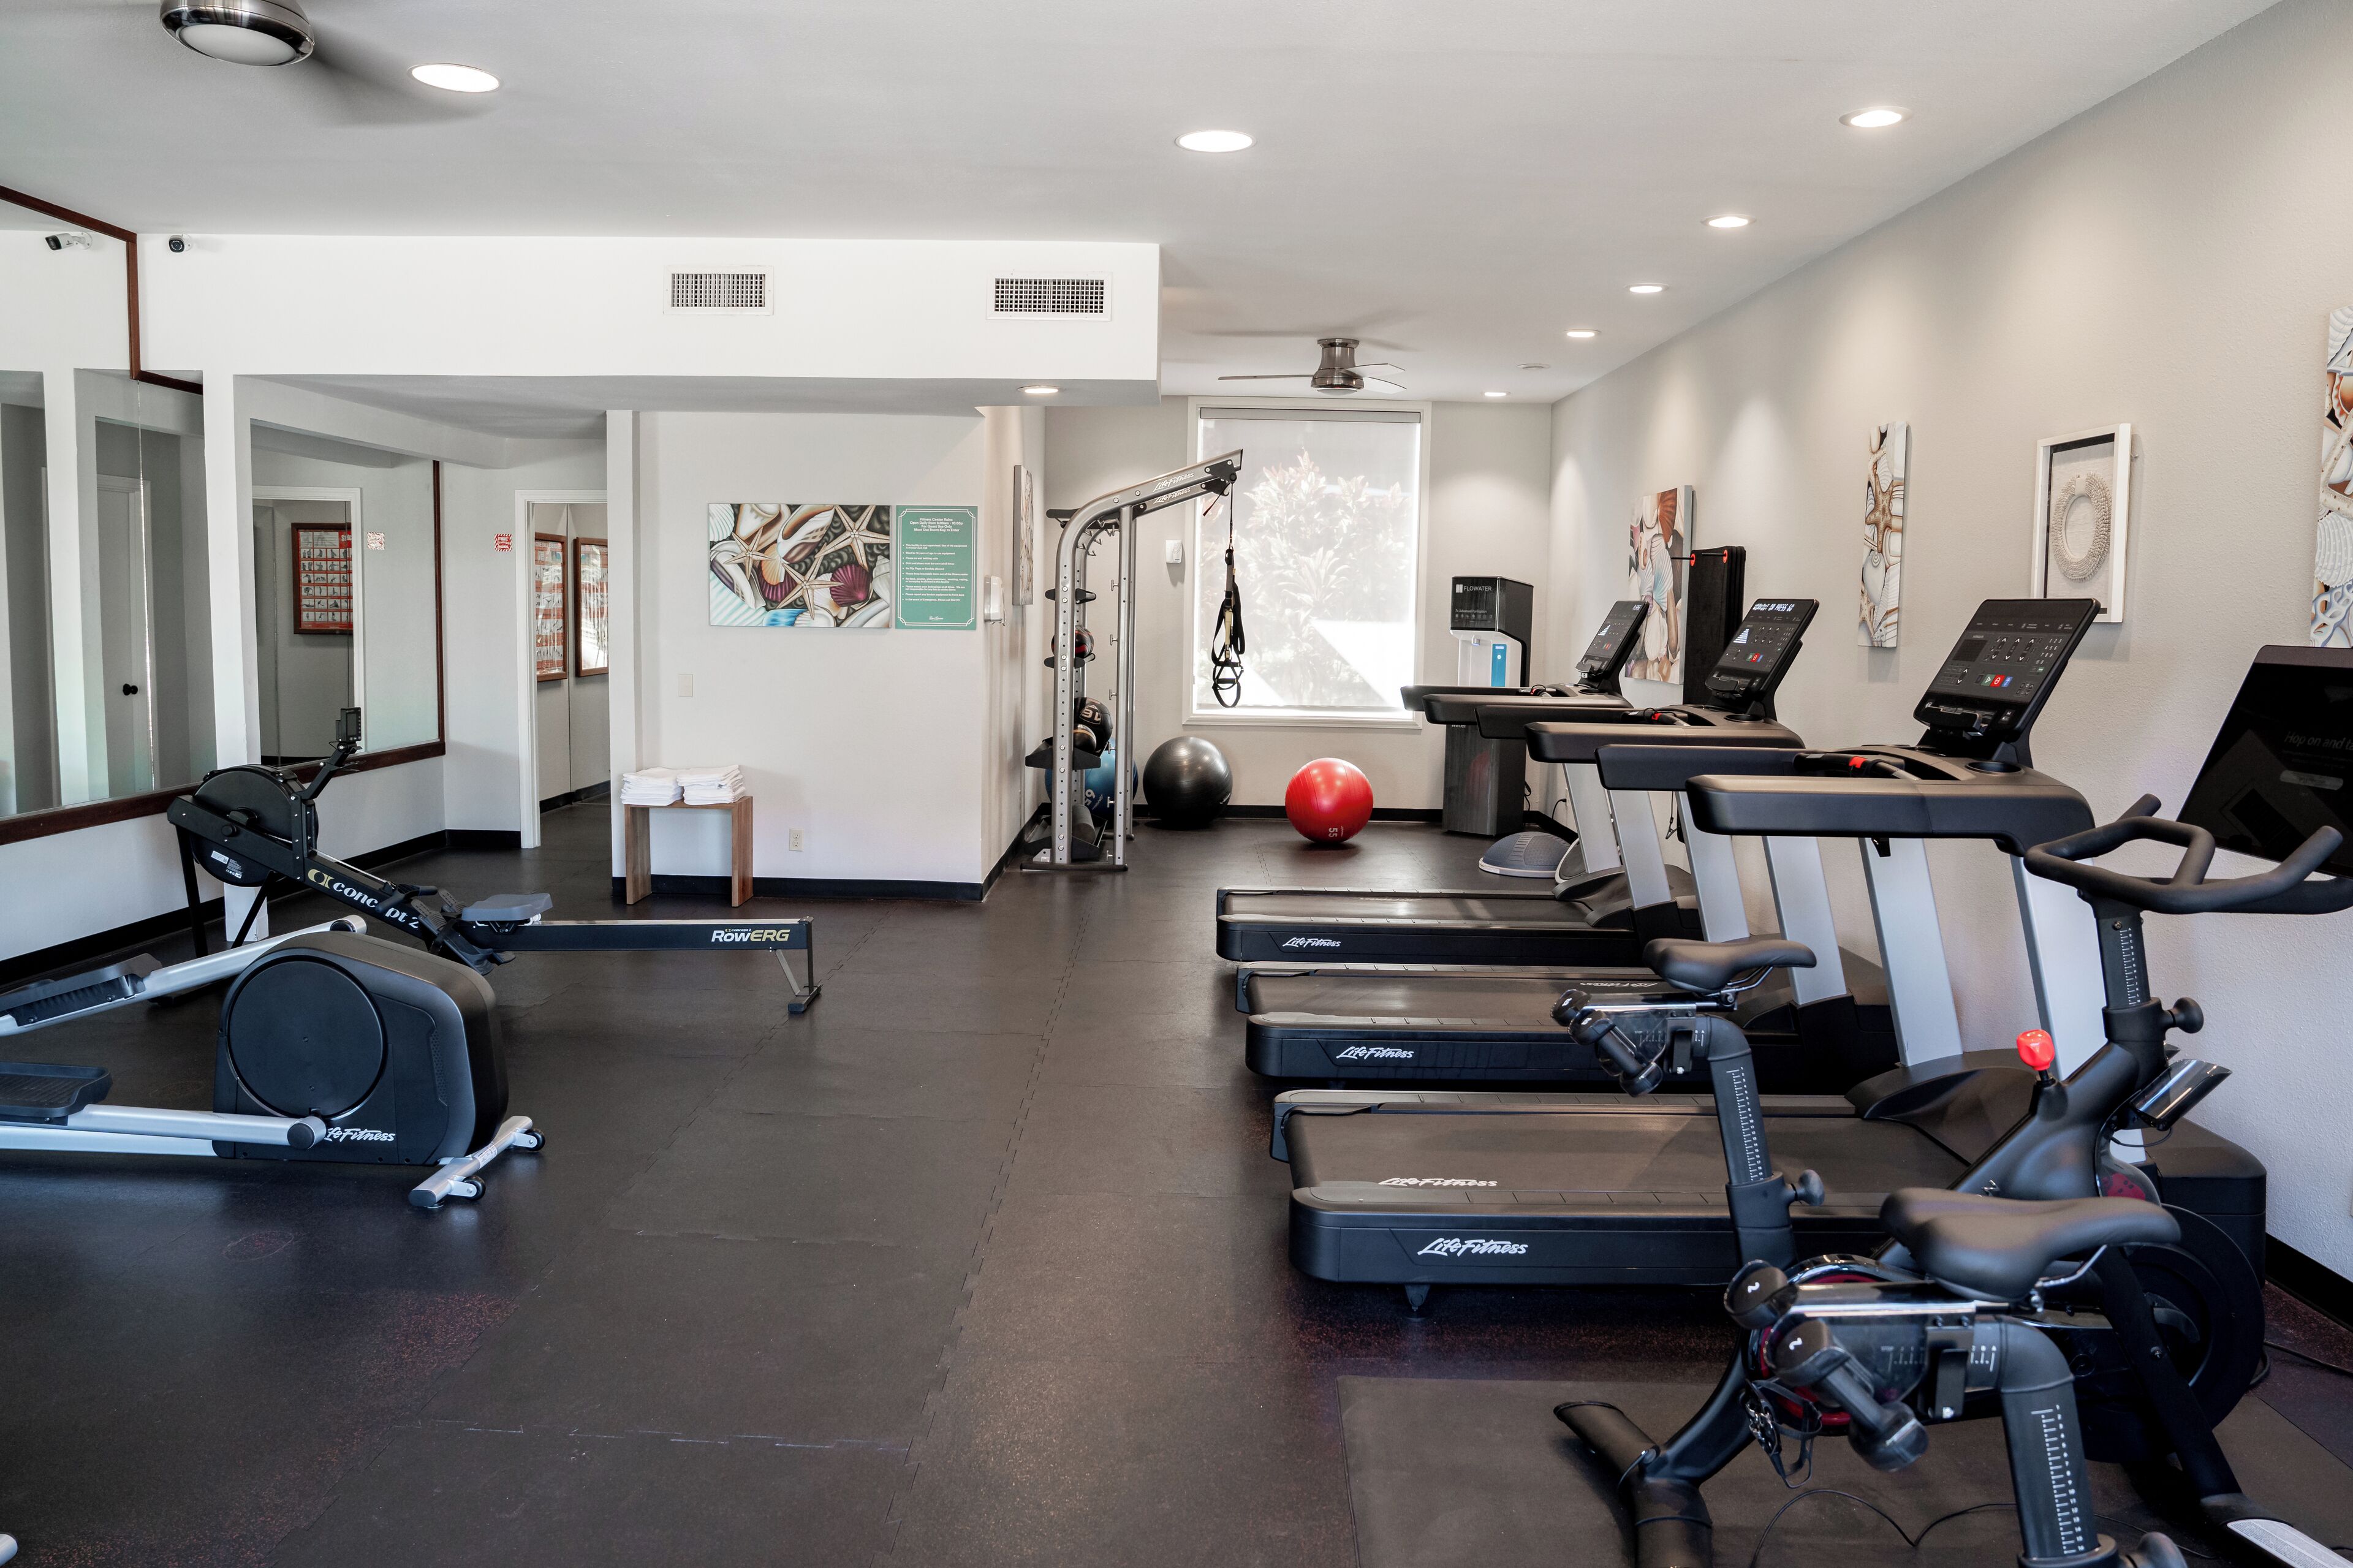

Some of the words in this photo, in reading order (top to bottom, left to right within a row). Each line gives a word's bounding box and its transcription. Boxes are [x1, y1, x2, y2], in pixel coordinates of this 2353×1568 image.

[2284, 731, 2305, 746] Hop
[2308, 737, 2321, 746] on
[2322, 737, 2346, 749] and
[1328, 827, 1338, 838] 55
[333, 882, 408, 922] concpt
[711, 929, 790, 942] RowERG
